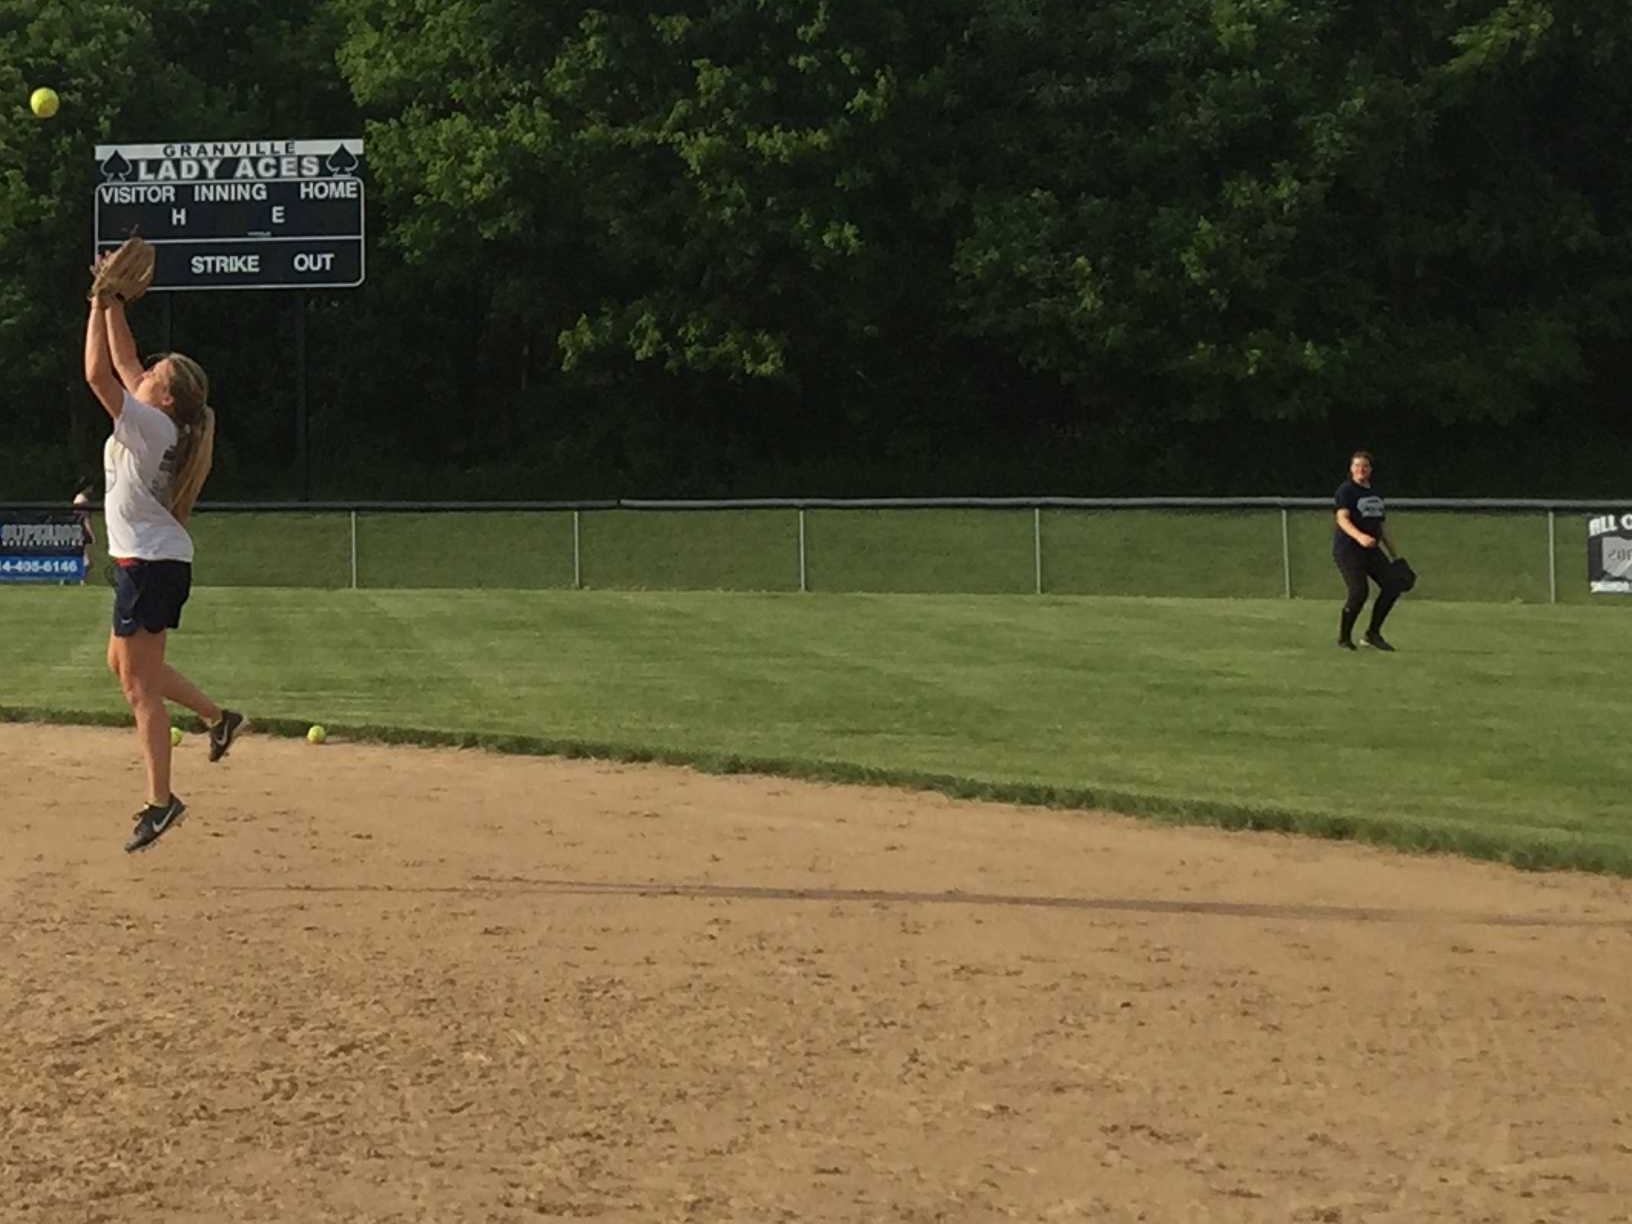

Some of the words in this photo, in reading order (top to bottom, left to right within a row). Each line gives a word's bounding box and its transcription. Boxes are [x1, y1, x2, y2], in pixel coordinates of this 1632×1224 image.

[163, 140, 296, 157] GRANVILLE
[138, 158, 221, 180] LADY
[234, 156, 320, 178] ACES
[101, 186, 176, 204] VISITOR
[194, 183, 268, 201] INNING
[300, 181, 358, 199] HOME
[171, 208, 186, 226] H
[272, 207, 285, 224] E
[191, 256, 260, 274] STRIKE
[293, 253, 335, 271] OUT
